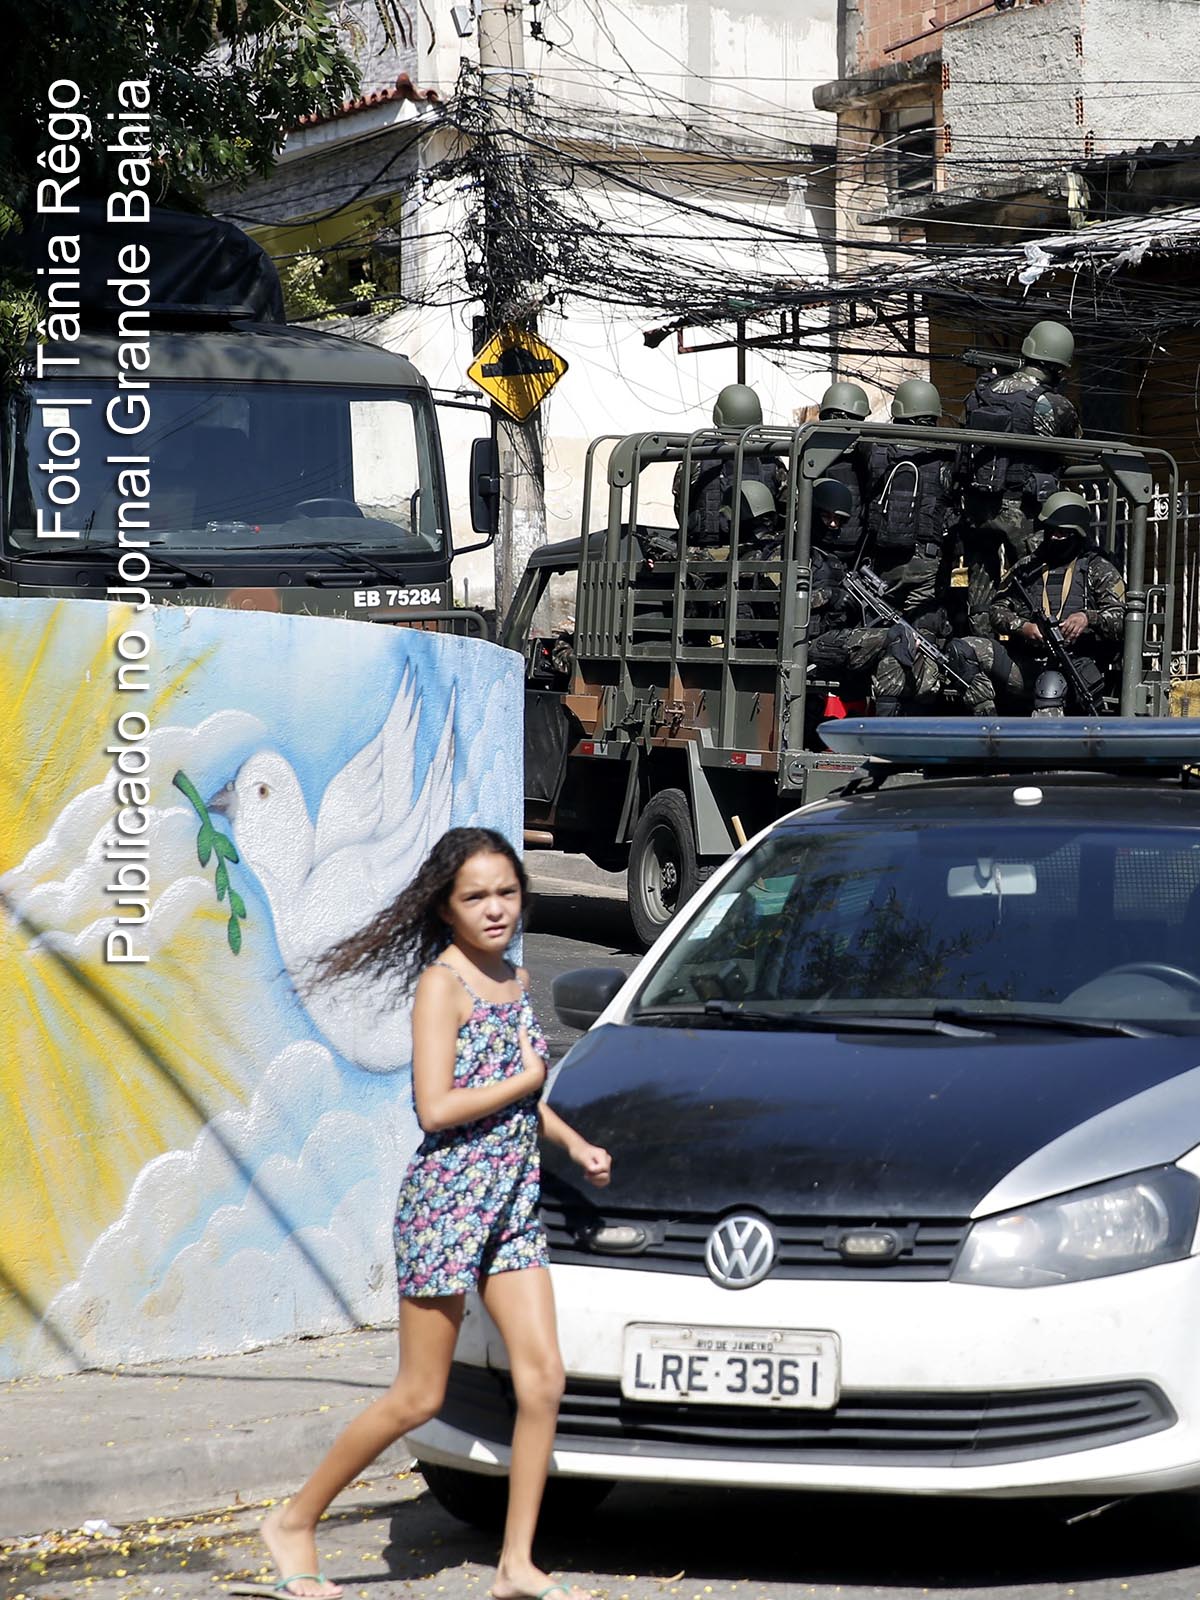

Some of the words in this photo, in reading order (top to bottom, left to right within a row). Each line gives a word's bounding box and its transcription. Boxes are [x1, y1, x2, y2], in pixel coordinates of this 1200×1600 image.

[353, 590, 380, 607] EB
[386, 588, 441, 606] 75284
[697, 1339, 713, 1349] RIO
[715, 1341, 728, 1350] DE
[732, 1341, 773, 1352] JANEIRO
